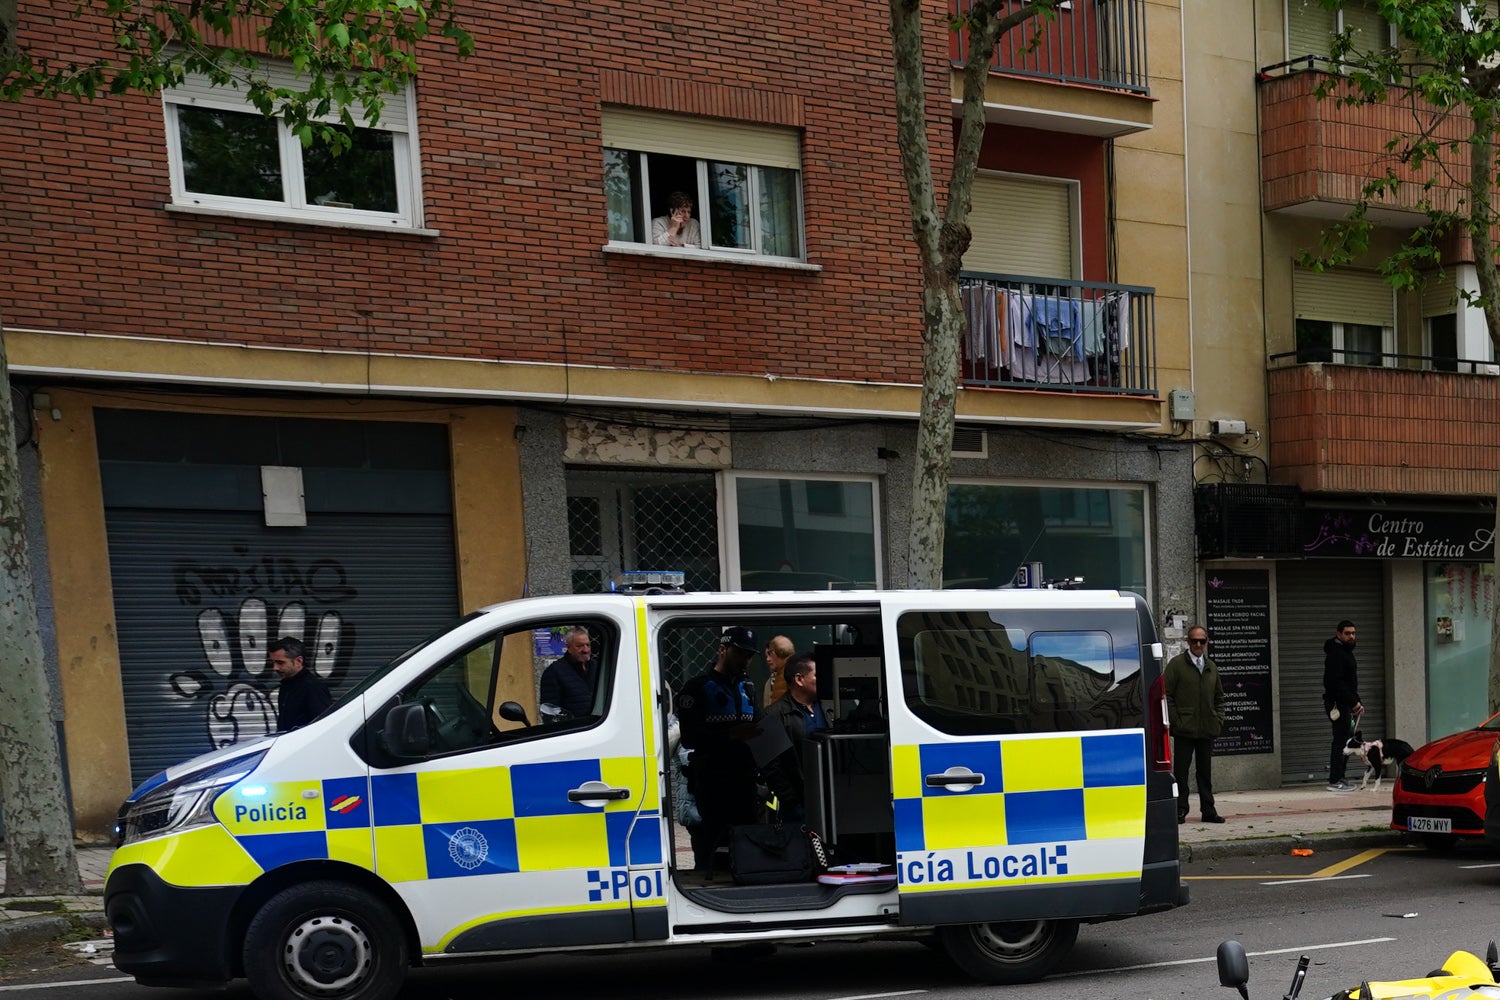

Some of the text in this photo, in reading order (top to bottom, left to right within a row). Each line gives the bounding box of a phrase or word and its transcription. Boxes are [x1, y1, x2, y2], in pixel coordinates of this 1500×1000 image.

[1368, 512, 1424, 534] Centro
[1376, 536, 1465, 558] de Estética
[235, 801, 307, 823] Policía
[1412, 819, 1449, 831] 4276 MVY
[967, 847, 1048, 880] Local
[611, 870, 663, 900] Pol
